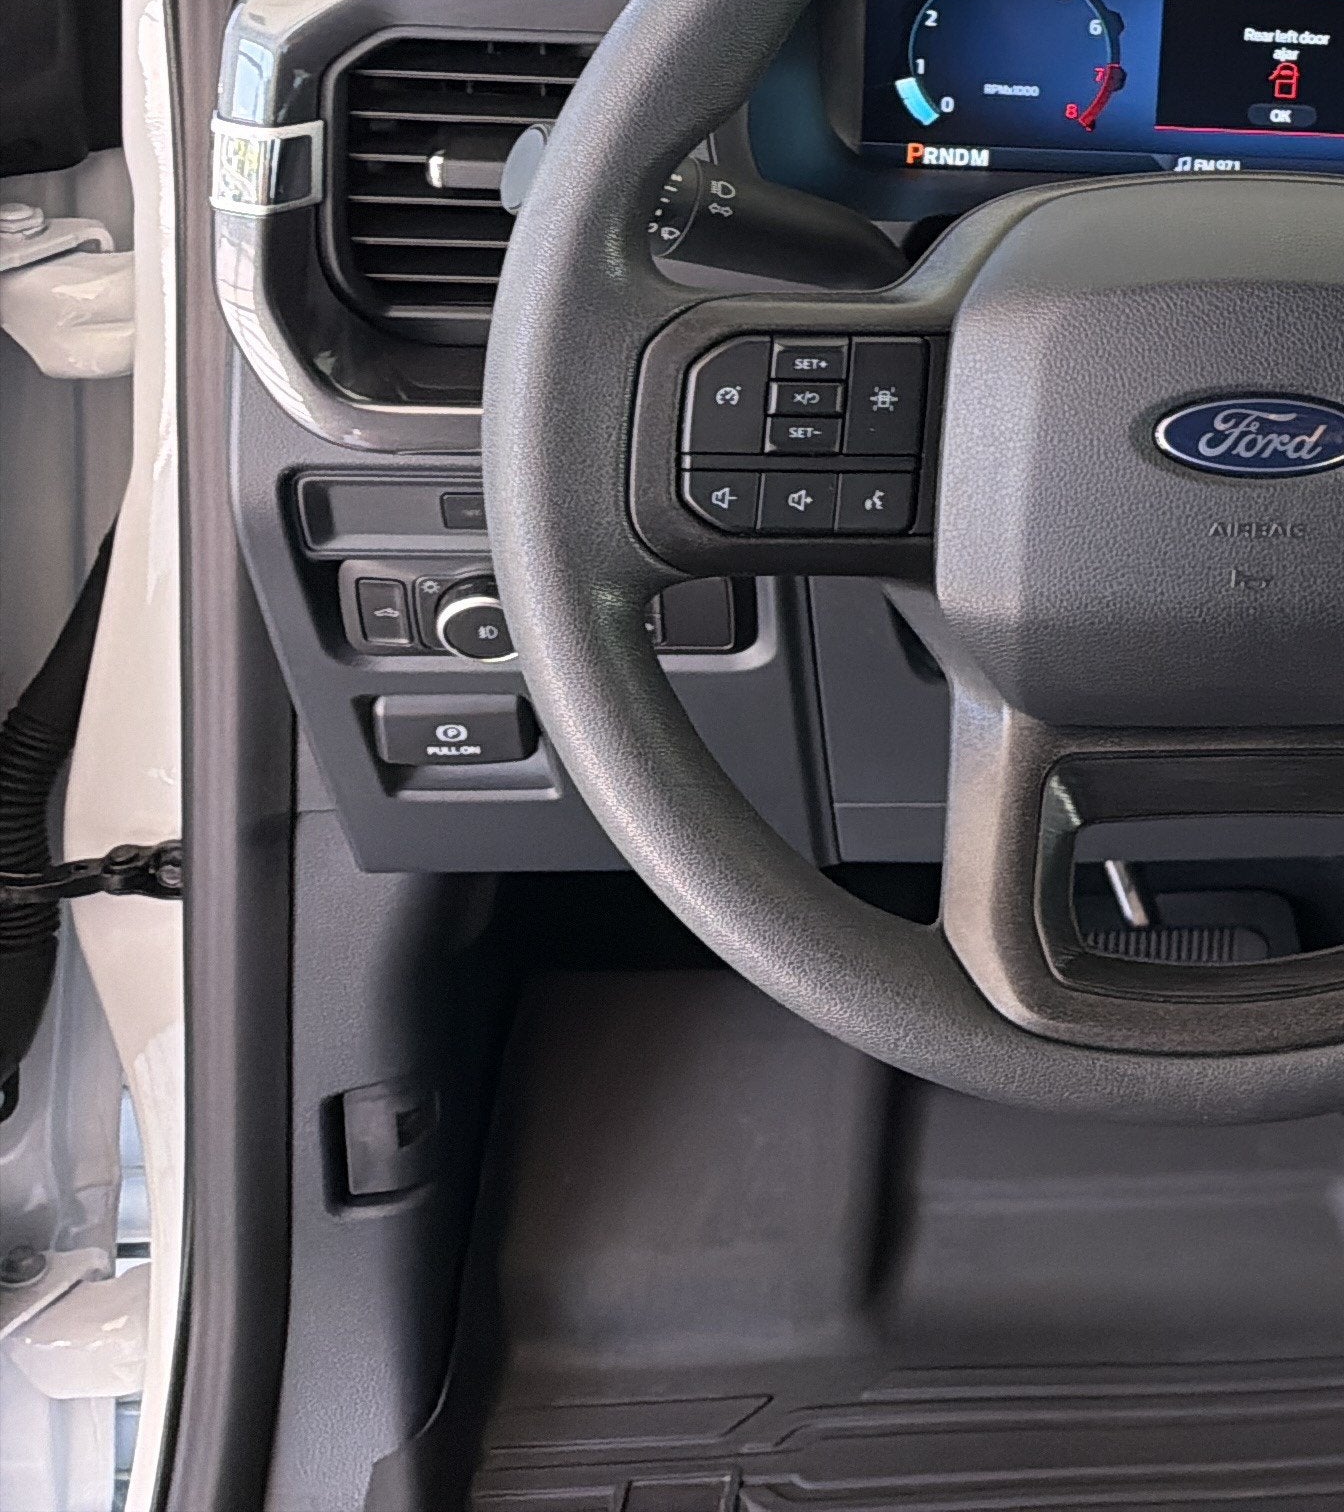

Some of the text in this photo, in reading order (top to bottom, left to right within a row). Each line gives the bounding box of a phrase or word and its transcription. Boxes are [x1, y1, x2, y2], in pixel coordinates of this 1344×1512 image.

[924, 9, 938, 27] 2
[1089, 19, 1103, 36] 6
[1243, 27, 1331, 46] Rear left door
[1272, 47, 1300, 62] ajar
[915, 58, 926, 75] 1
[1093, 67, 1105, 83] 7
[940, 97, 955, 113] 0
[1065, 103, 1079, 119] 8
[1269, 108, 1292, 124] OK
[1193, 158, 1215, 172] FM
[794, 358, 829, 370] SET+
[1198, 408, 1328, 459] Ford
[426, 745, 481, 755] PULL ON
